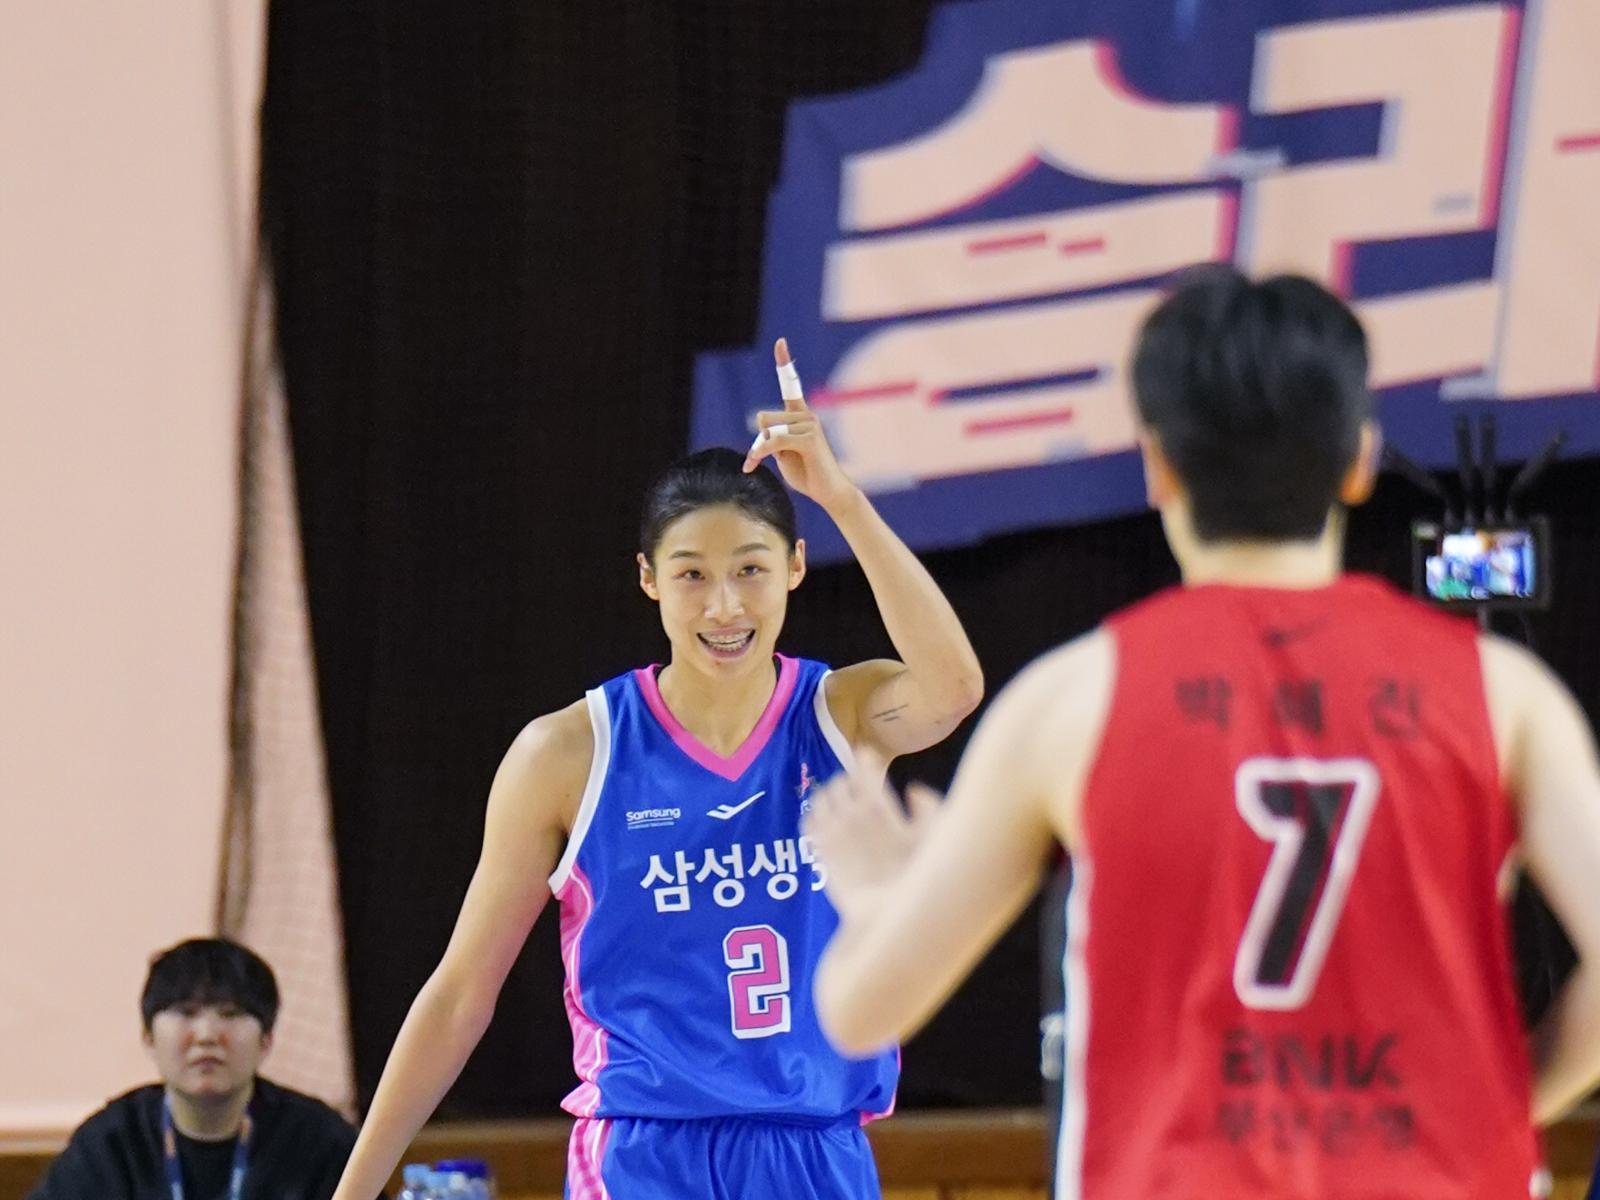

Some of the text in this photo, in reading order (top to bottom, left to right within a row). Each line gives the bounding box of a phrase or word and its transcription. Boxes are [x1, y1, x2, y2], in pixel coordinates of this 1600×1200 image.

[626, 808, 681, 821] Samsung
[1235, 757, 1381, 1011] 7
[723, 925, 790, 1039] 2
